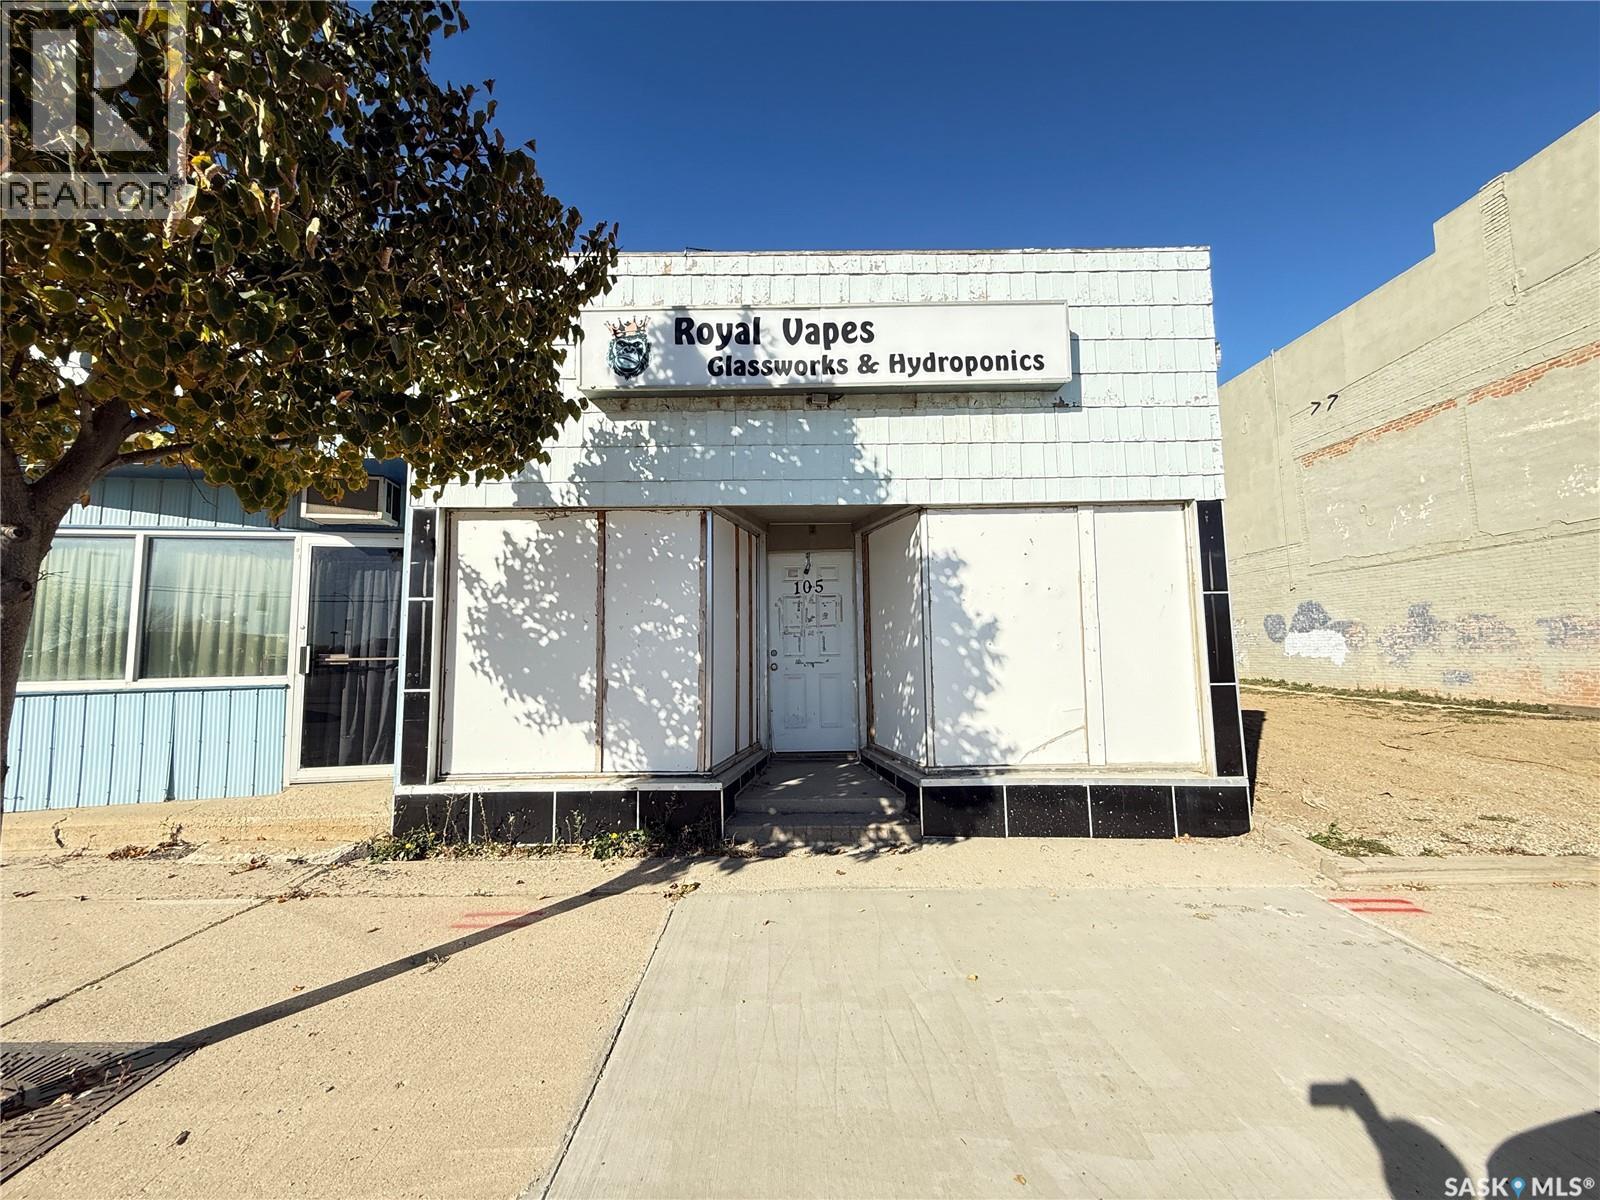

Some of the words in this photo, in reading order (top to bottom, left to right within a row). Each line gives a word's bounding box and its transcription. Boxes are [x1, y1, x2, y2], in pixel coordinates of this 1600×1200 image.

[674, 316, 761, 351] Royal
[783, 318, 875, 350] Vapes
[707, 355, 848, 377] Glassworks
[858, 354, 879, 374] &
[889, 350, 1045, 378] Hydroponics
[793, 579, 824, 595] 105
